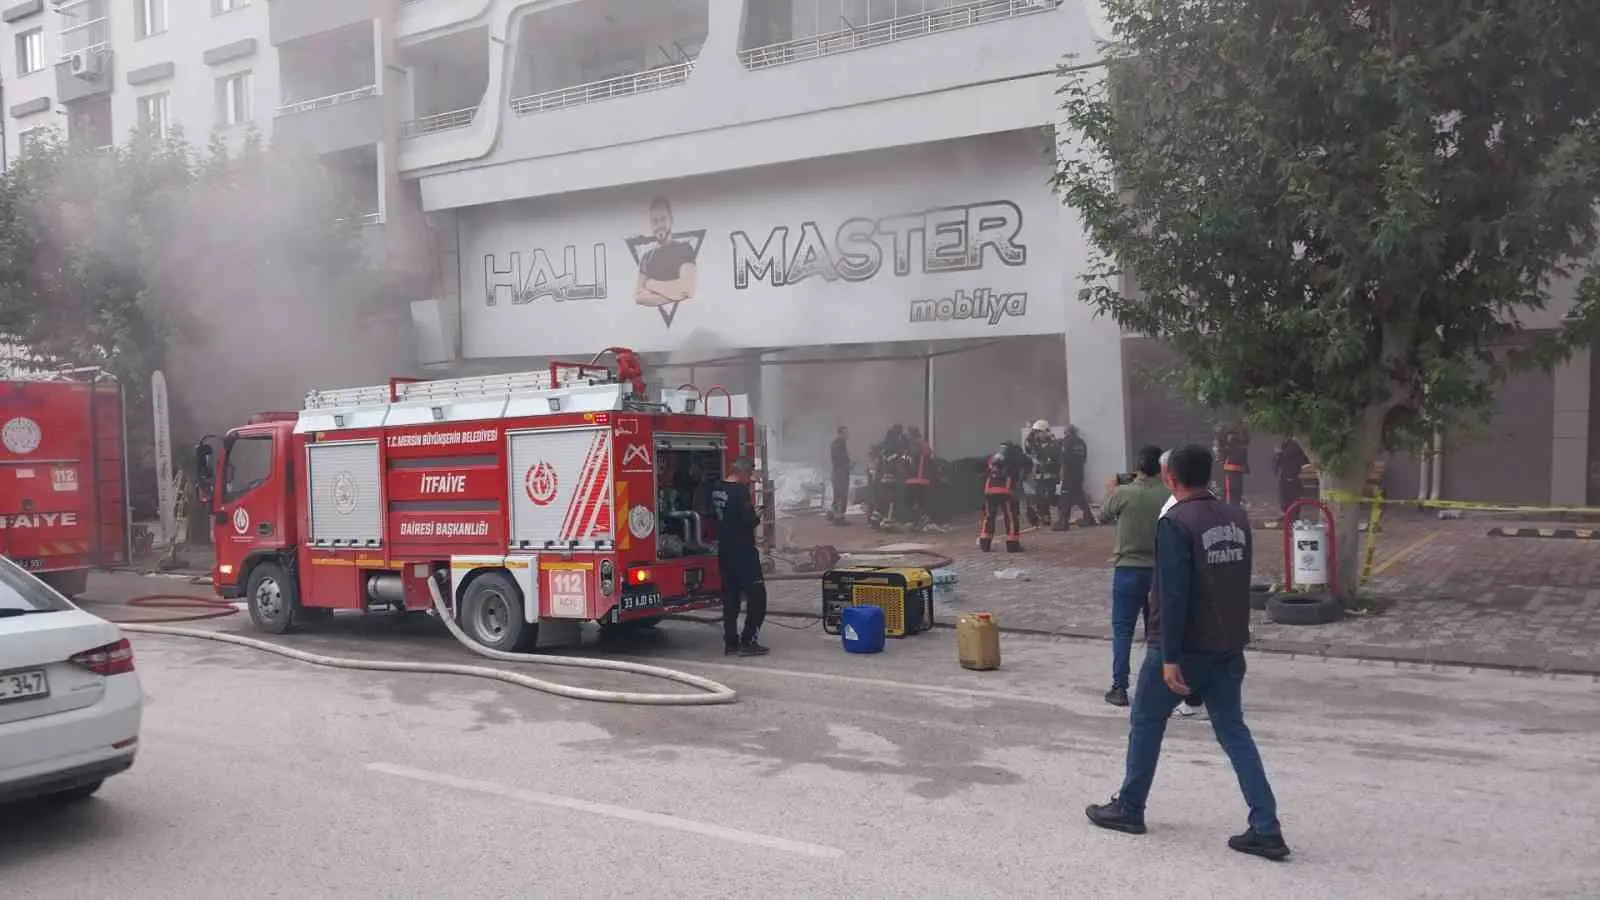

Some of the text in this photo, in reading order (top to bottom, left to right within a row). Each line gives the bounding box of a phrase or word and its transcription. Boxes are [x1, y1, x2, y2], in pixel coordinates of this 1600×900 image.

[484, 200, 1027, 306] HALI MASTER
[910, 288, 1027, 325] mobilya
[422, 430, 461, 447] BÜYÜKŞEHİR
[461, 427, 498, 444] BELEDİYESİ
[55, 470, 74, 482] 112
[420, 472, 466, 494] İTFAİYE
[400, 520, 489, 537] DAİRESİ BAŞKANLIĞI
[553, 574, 581, 593] 112
[12, 673, 42, 694] 347
